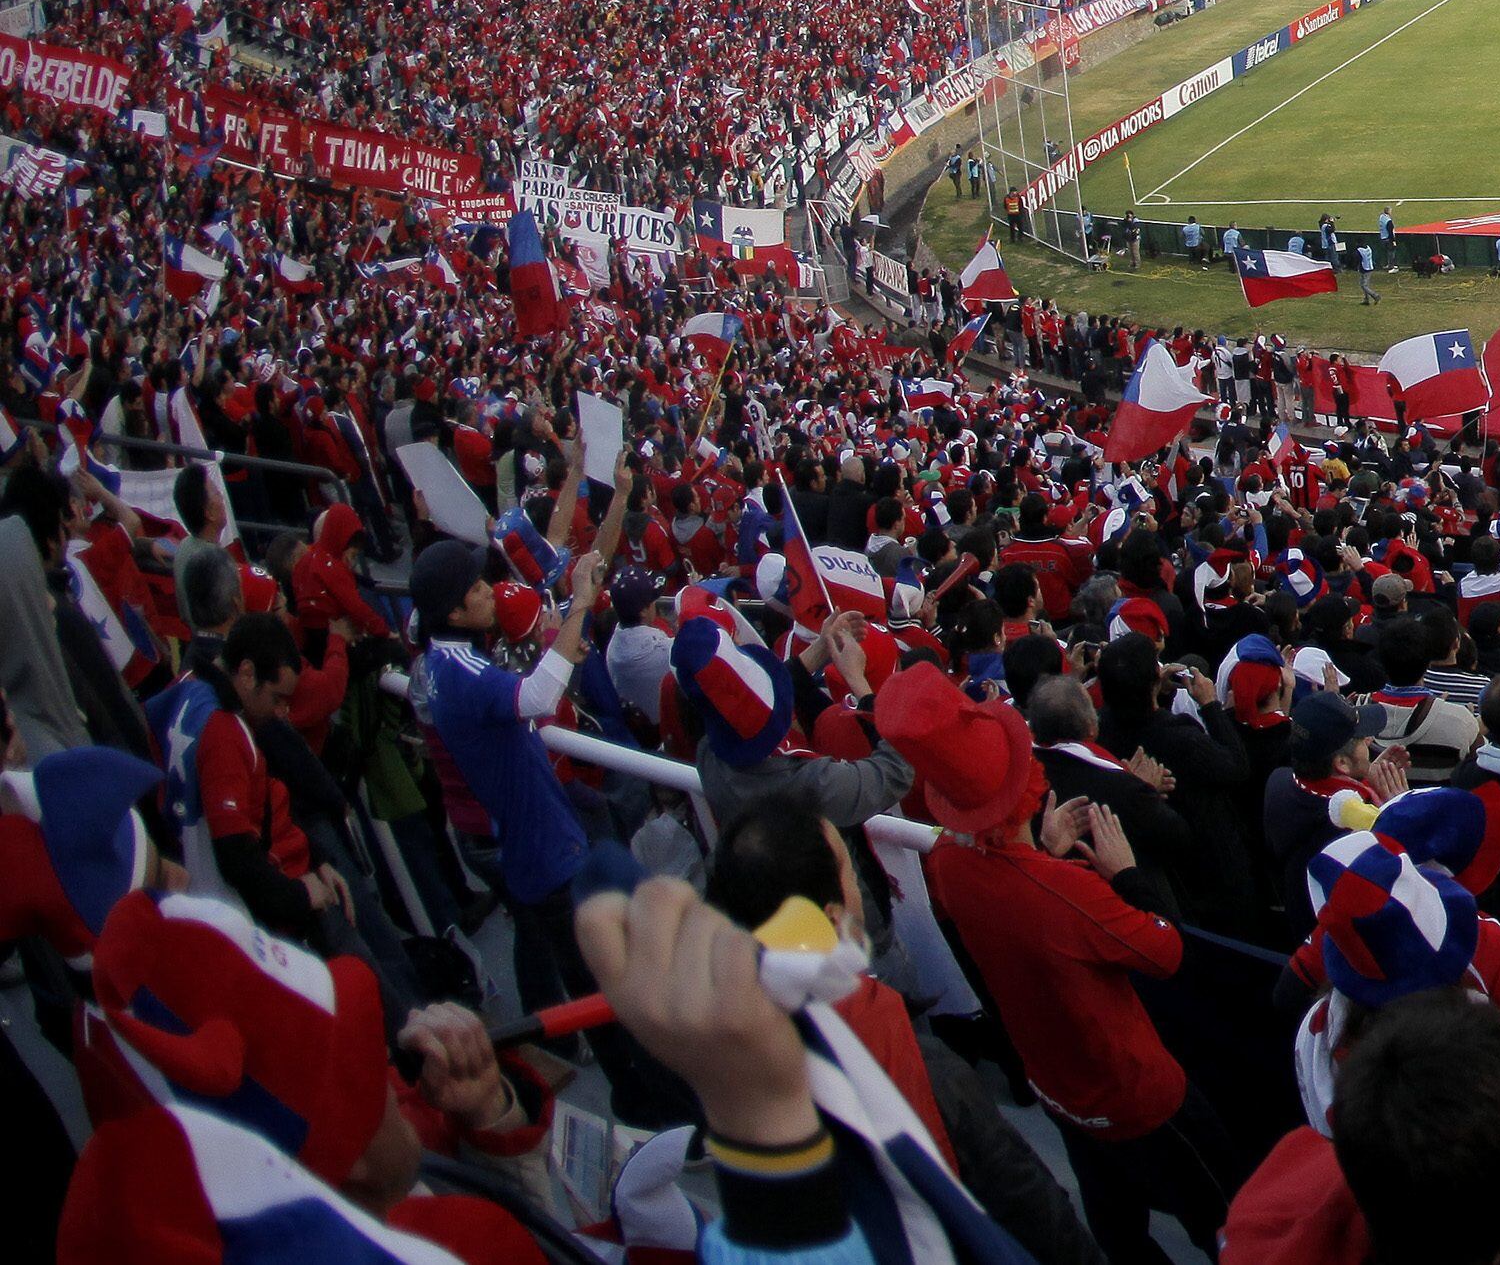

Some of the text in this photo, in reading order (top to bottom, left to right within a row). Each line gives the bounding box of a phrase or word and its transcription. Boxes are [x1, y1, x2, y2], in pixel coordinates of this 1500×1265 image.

[1304, 3, 1340, 35] Santander
[1254, 32, 1281, 67] telcel
[23, 52, 130, 116] REBELDE
[1178, 67, 1219, 107] Canon
[224, 113, 289, 157] PRFE
[325, 136, 386, 172] TOMA
[416, 151, 459, 173] VAMOS
[1100, 128, 1120, 153] KIA
[1120, 100, 1162, 141] MOTORS
[402, 167, 450, 195] CHILE
[522, 160, 550, 178] SAN
[521, 179, 566, 201] PABLO
[582, 190, 620, 203] CRUCES
[518, 196, 677, 246] LAS CRUCES
[1289, 471, 1305, 489] 10
